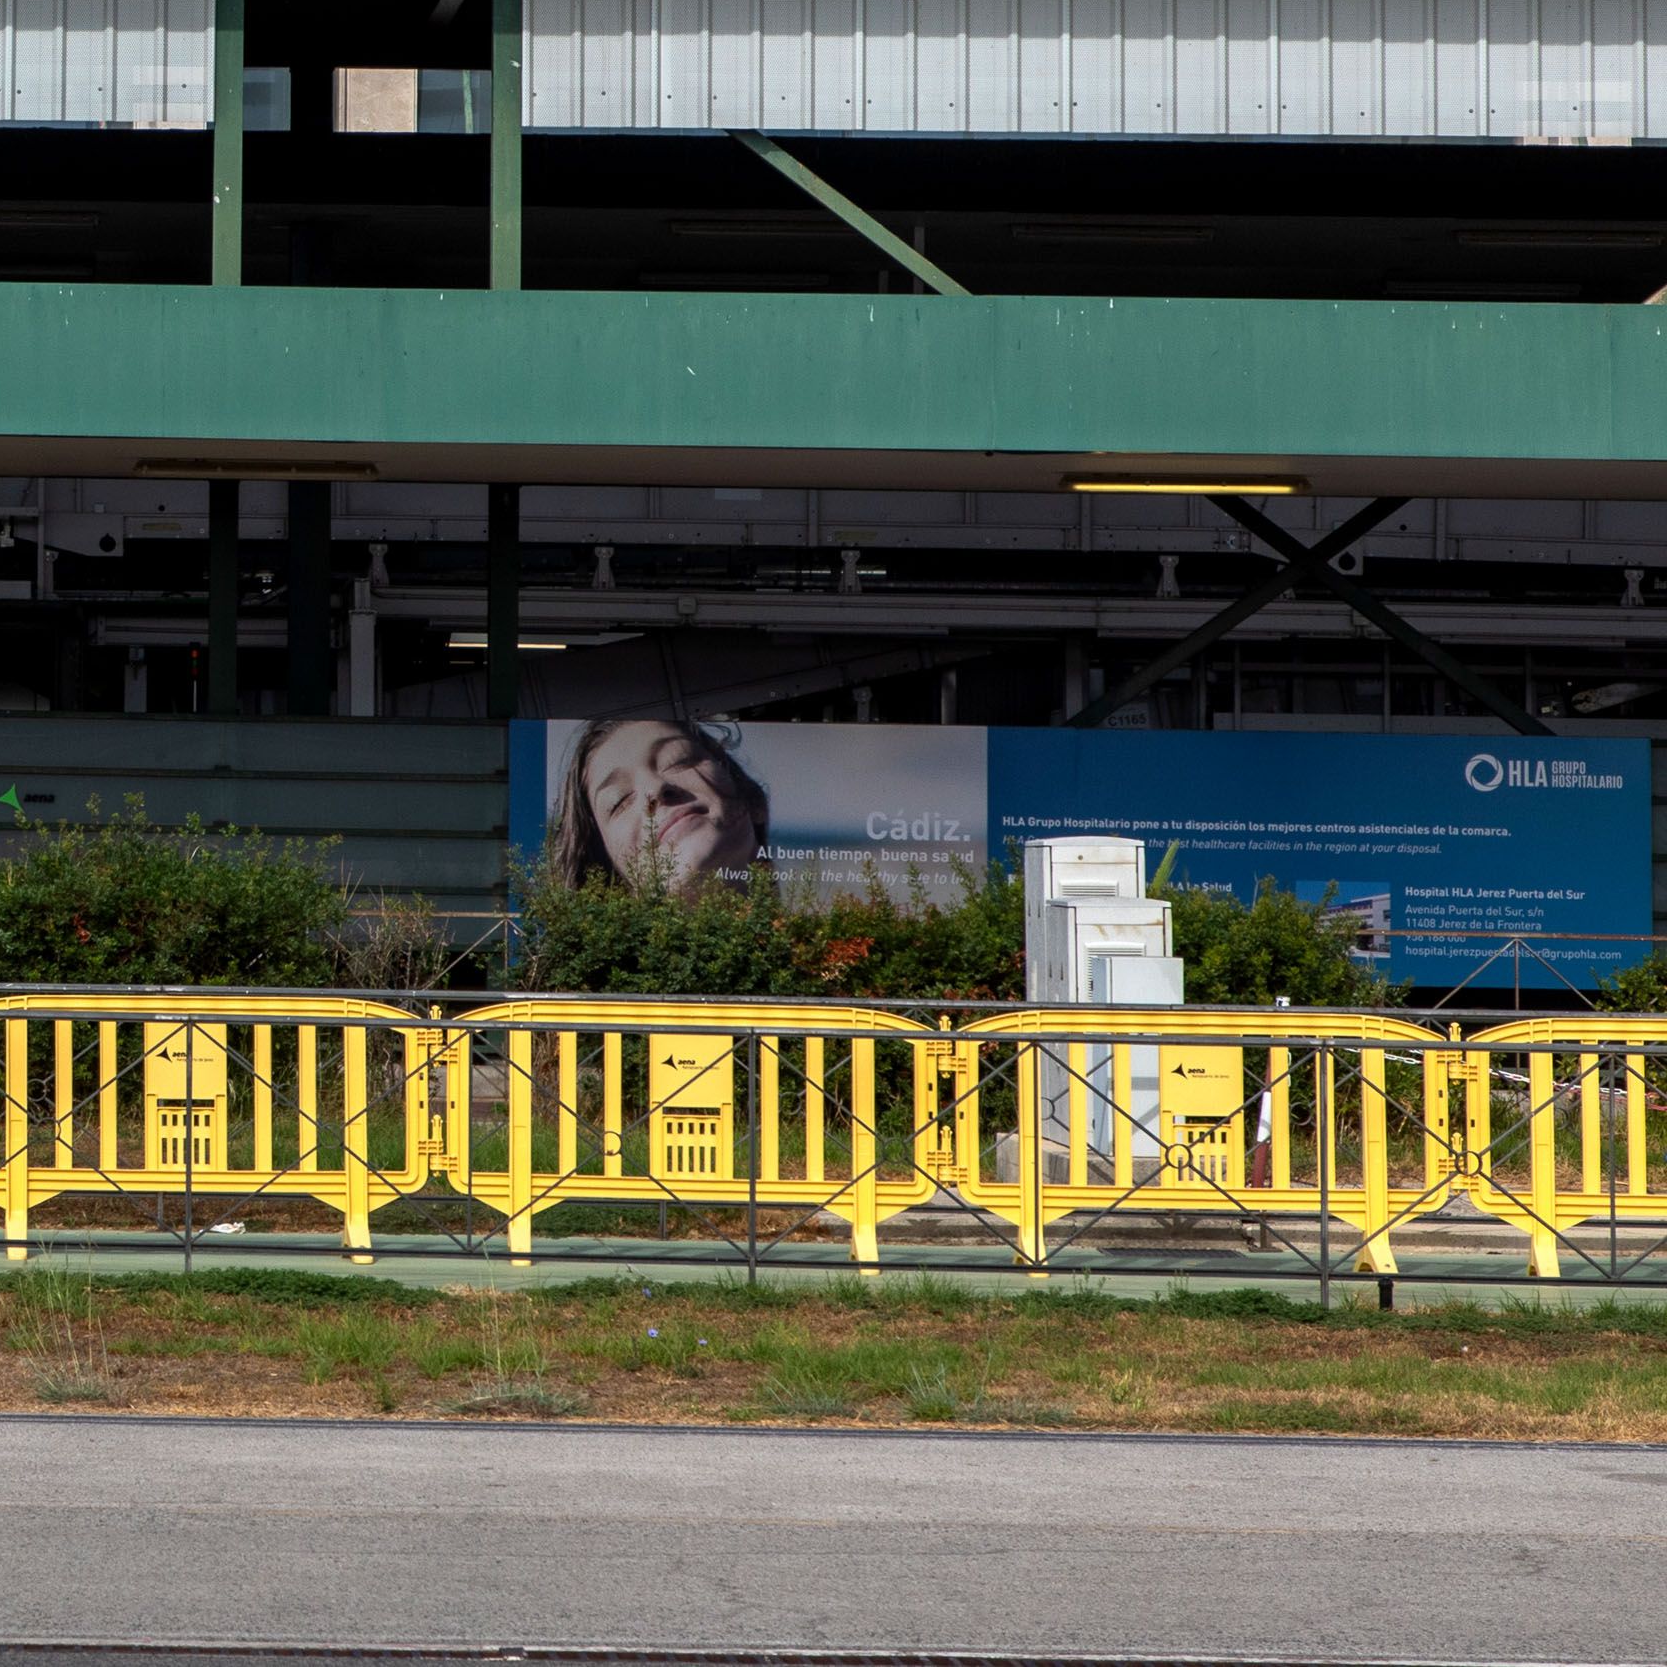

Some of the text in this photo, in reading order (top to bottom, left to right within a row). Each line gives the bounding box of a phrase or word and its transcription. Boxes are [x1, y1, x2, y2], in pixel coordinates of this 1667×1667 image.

[1509, 760, 1548, 787] HLA
[1551, 761, 1586, 775] GRUPO
[1551, 775, 1623, 789] HOSPITALARIO
[24, 794, 55, 803] aena
[866, 809, 971, 842] Cádiz.
[1002, 816, 1025, 826] HLA
[1027, 817, 1061, 829] Grupo
[1064, 818, 1130, 829] Hospitalario
[1133, 820, 1159, 831] pone
[1171, 821, 1182, 829] tu
[1185, 821, 1246, 832] disposición
[1249, 822, 1265, 831] los
[1267, 822, 1312, 834] mejores
[1315, 824, 1356, 833] centros
[1358, 824, 1430, 835] asistenciales
[1432, 825, 1445, 835] de
[1448, 825, 1459, 835] la
[1461, 827, 1512, 836] comarca.
[756, 845, 772, 859] Al
[777, 846, 814, 860] buen
[881, 848, 927, 862] buena
[1148, 838, 1164, 848] the
[1191, 839, 1246, 849] healthcare
[1248, 839, 1291, 850] facilities
[1293, 840, 1303, 850] in
[1305, 841, 1322, 851] the
[1324, 842, 1357, 854] region
[1359, 843, 1370, 852] at
[1371, 844, 1395, 855] your
[1397, 843, 1442, 856] disposal.
[821, 869, 843, 882] the
[934, 872, 947, 885] to
[1405, 886, 1585, 900] Hospital HLA Jerez Puerta del Sur
[1405, 904, 1544, 918] Avenida Puerta del Sur, s/n
[1406, 918, 1542, 931] 11408 Jerez de la Frontera
